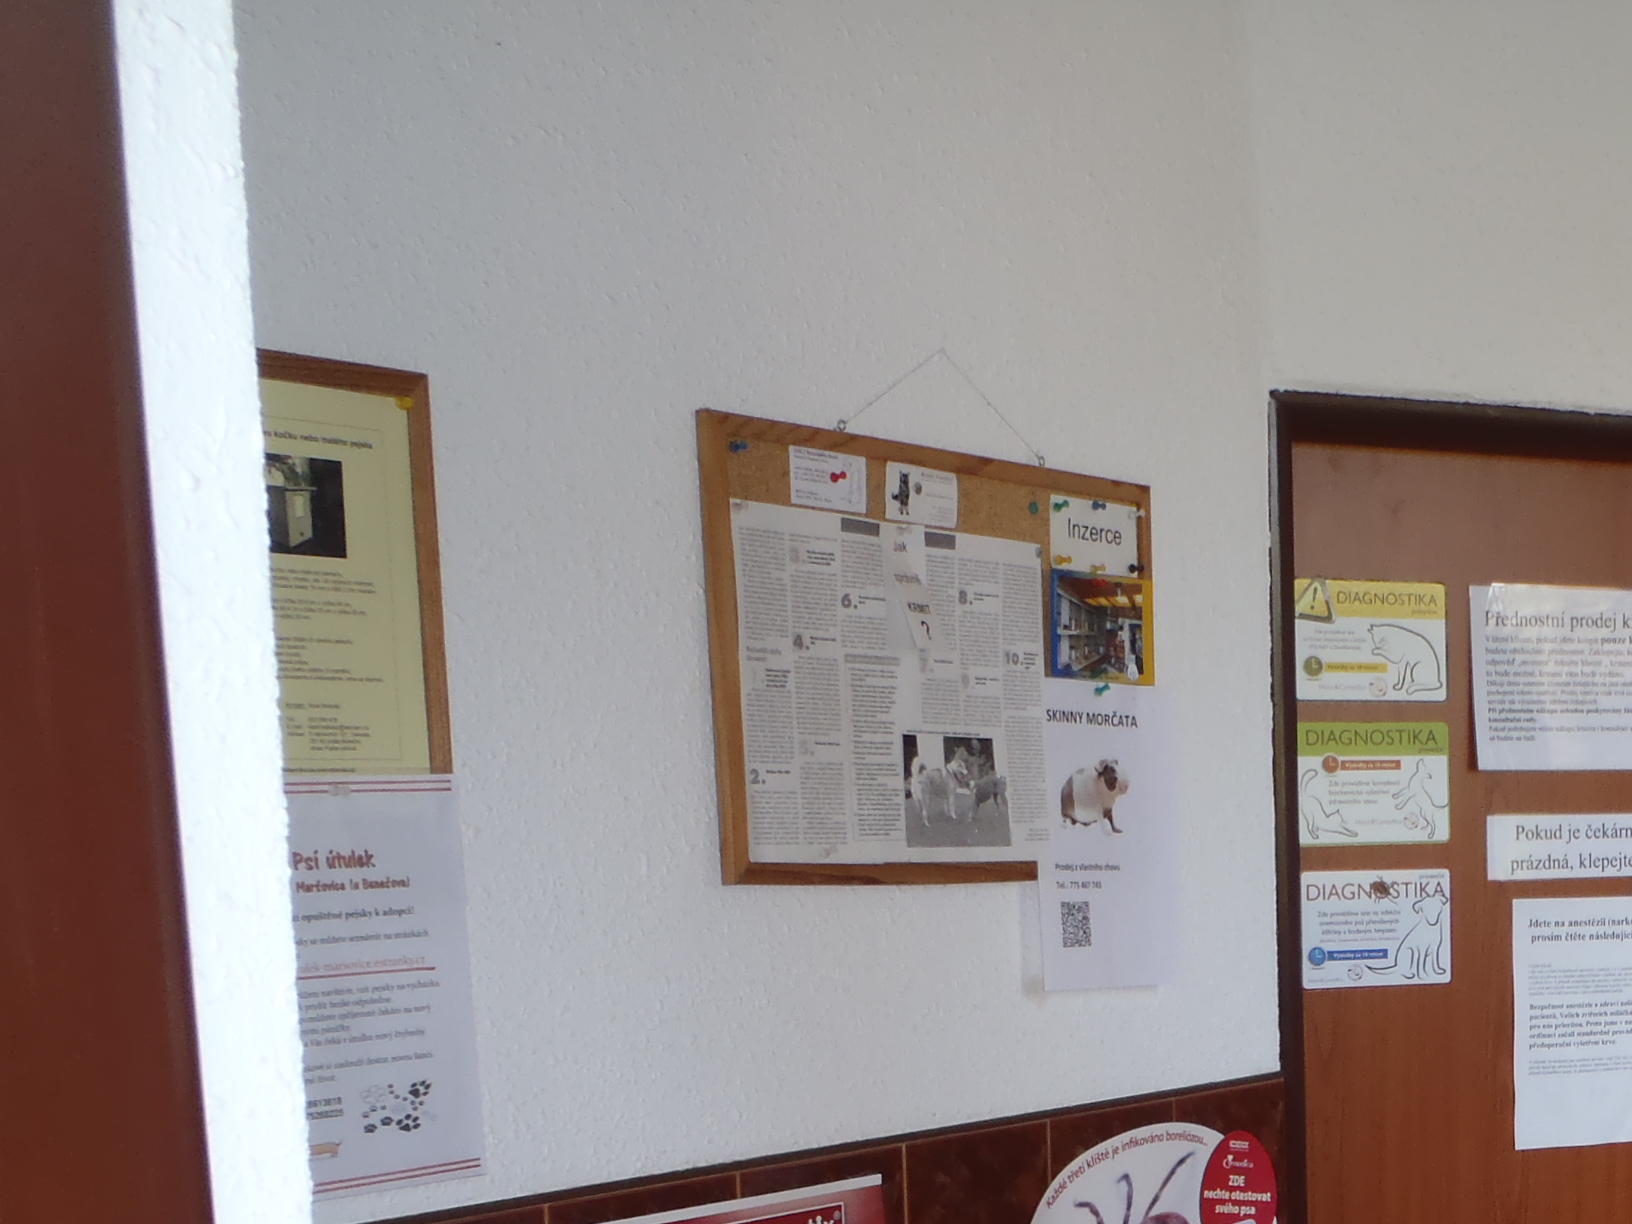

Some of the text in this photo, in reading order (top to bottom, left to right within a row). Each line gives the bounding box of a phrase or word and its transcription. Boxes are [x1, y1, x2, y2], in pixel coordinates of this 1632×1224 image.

[1067, 518, 1122, 546] Inzerce
[1336, 590, 1438, 607] DIAGNOSTIKA
[1484, 610, 1565, 629] Přednostní
[1570, 612, 1617, 633] prodej
[1046, 709, 1138, 728] SKINNY MORČATA
[1305, 729, 1438, 747] DIAGNOSTIKA
[1515, 823, 1563, 842] Pokud
[1565, 824, 1581, 844] je
[1510, 853, 1574, 876] prázdná,
[1527, 918, 1552, 928] Jdete
[1554, 920, 1565, 928] na
[1565, 931, 1586, 942] čtěte
[1045, 1179, 1068, 1210] Každé
[1067, 1166, 1087, 1184] třetí
[1086, 1149, 1111, 1170] klíště
[1111, 1145, 1121, 1160] je
[1121, 1132, 1165, 1152] infikováno
[1228, 1174, 1246, 1187] ZDE
[1203, 1188, 1272, 1202] nechte otestovat
[1215, 1202, 1256, 1217] svého psa
